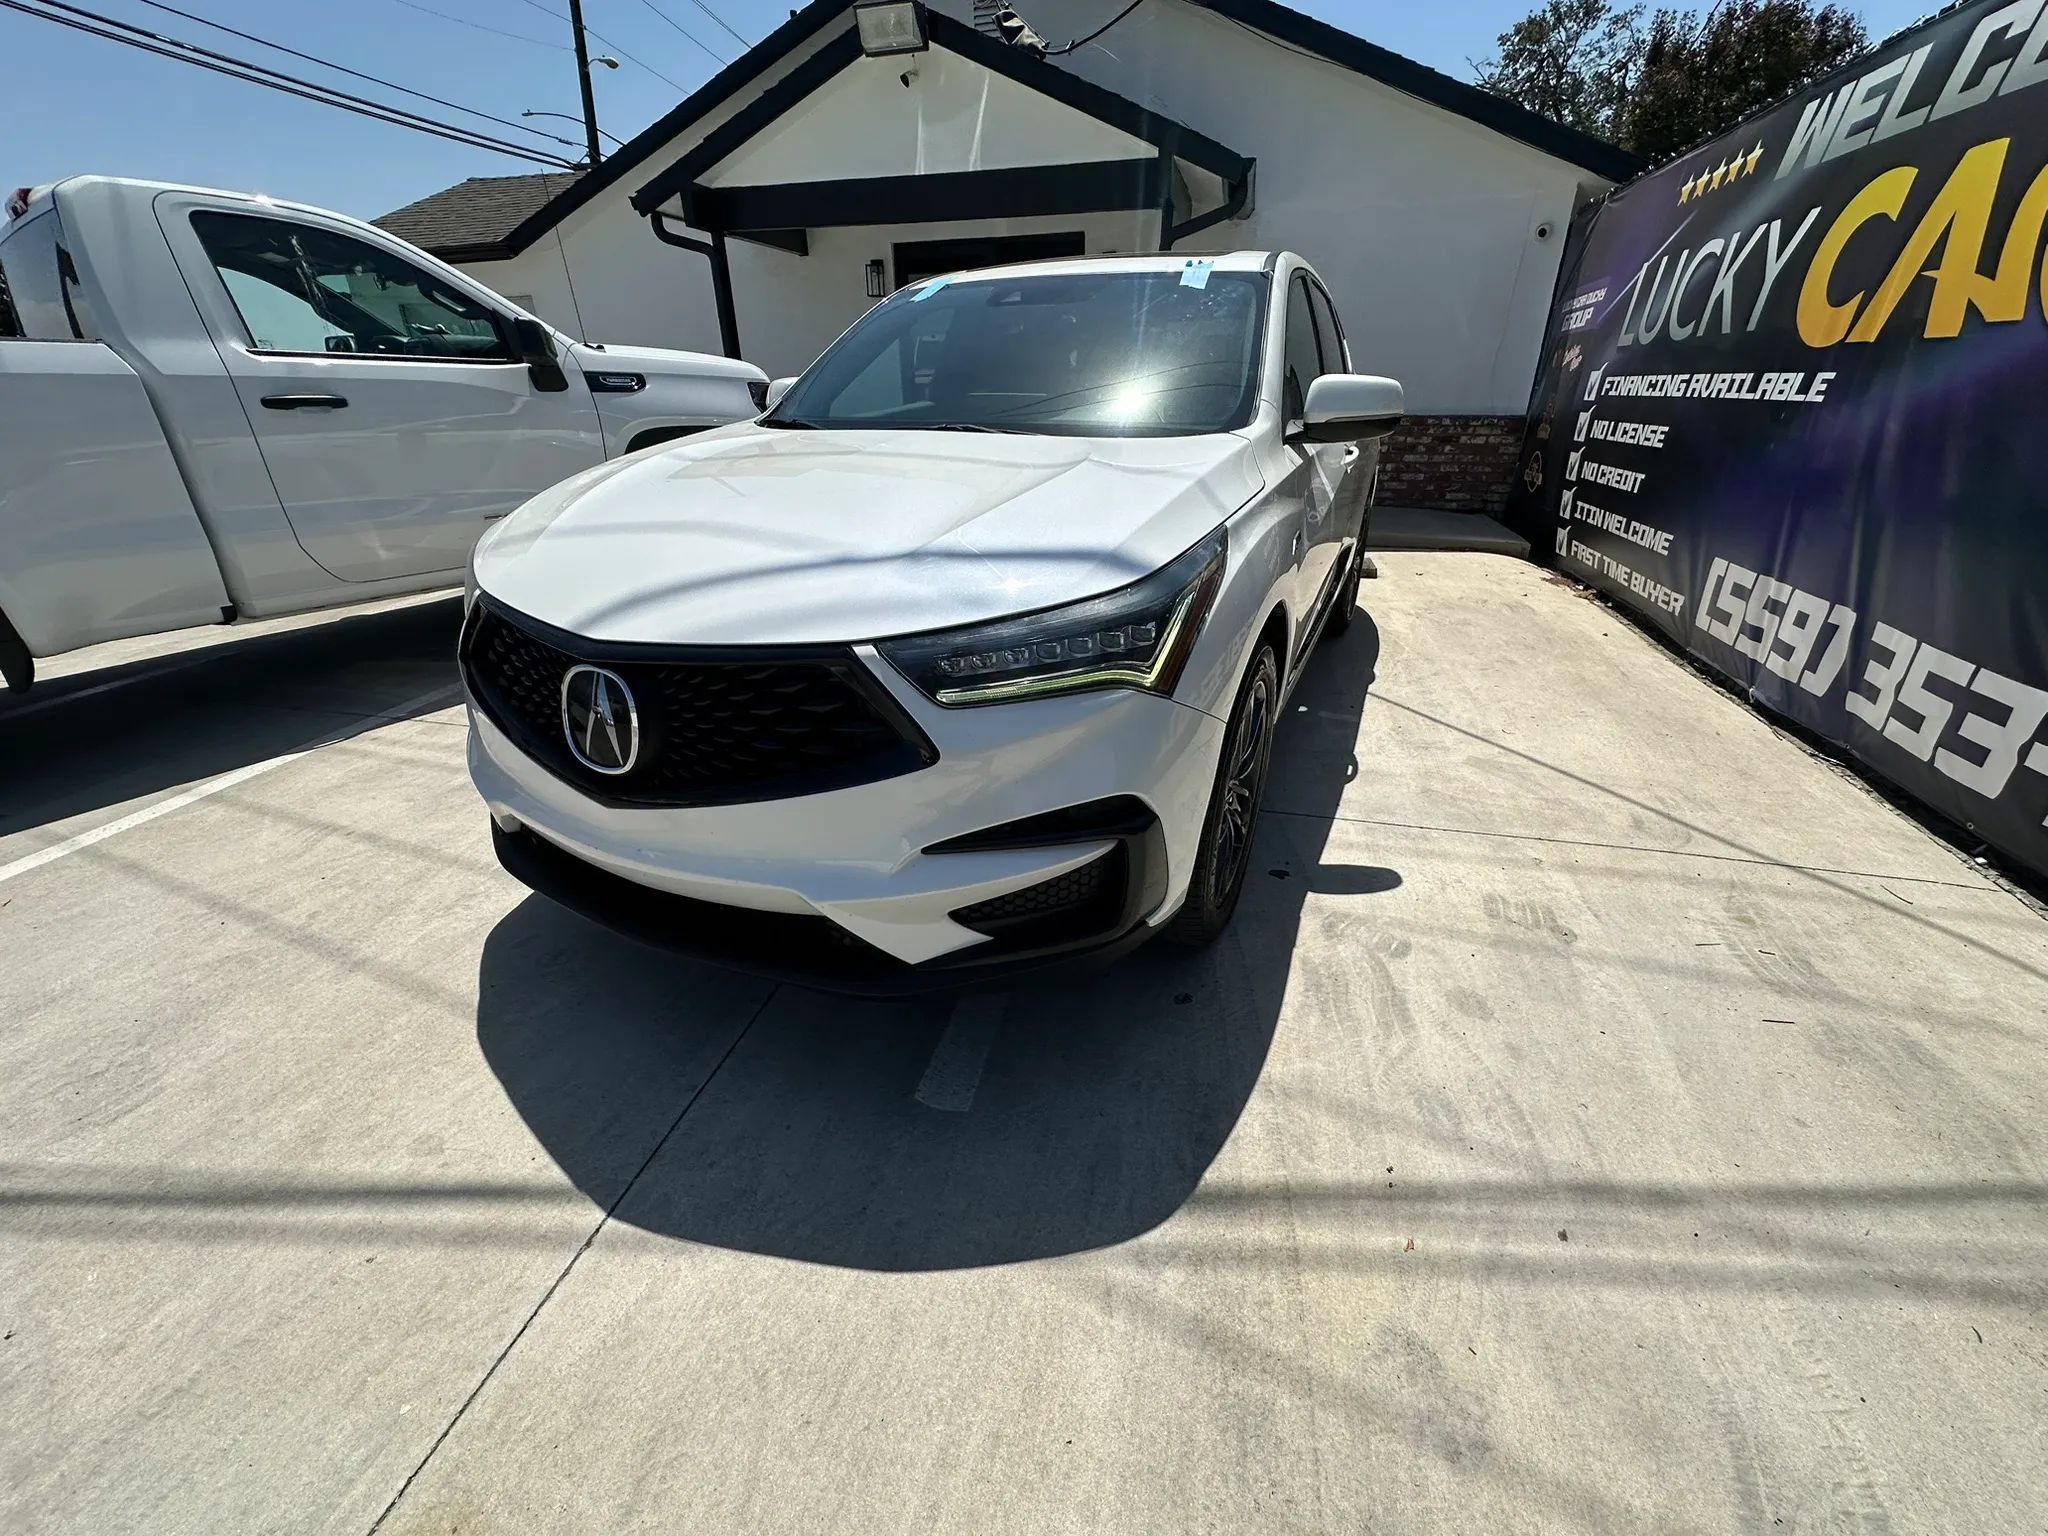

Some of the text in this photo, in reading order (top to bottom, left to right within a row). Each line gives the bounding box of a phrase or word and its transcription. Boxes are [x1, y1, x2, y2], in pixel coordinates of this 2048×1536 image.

[1617, 206, 1822, 347] LUCKY
[1601, 372, 1837, 402] FINANCING AVAILABLE
[1590, 420, 1669, 448] NO LICENSE
[1581, 461, 1645, 493] NO CREDIT
[1574, 501, 1674, 556] ITIN WELCOME
[1570, 540, 1685, 616] FIRST TIME BUYER
[1695, 557, 2048, 824] (559) 353-
